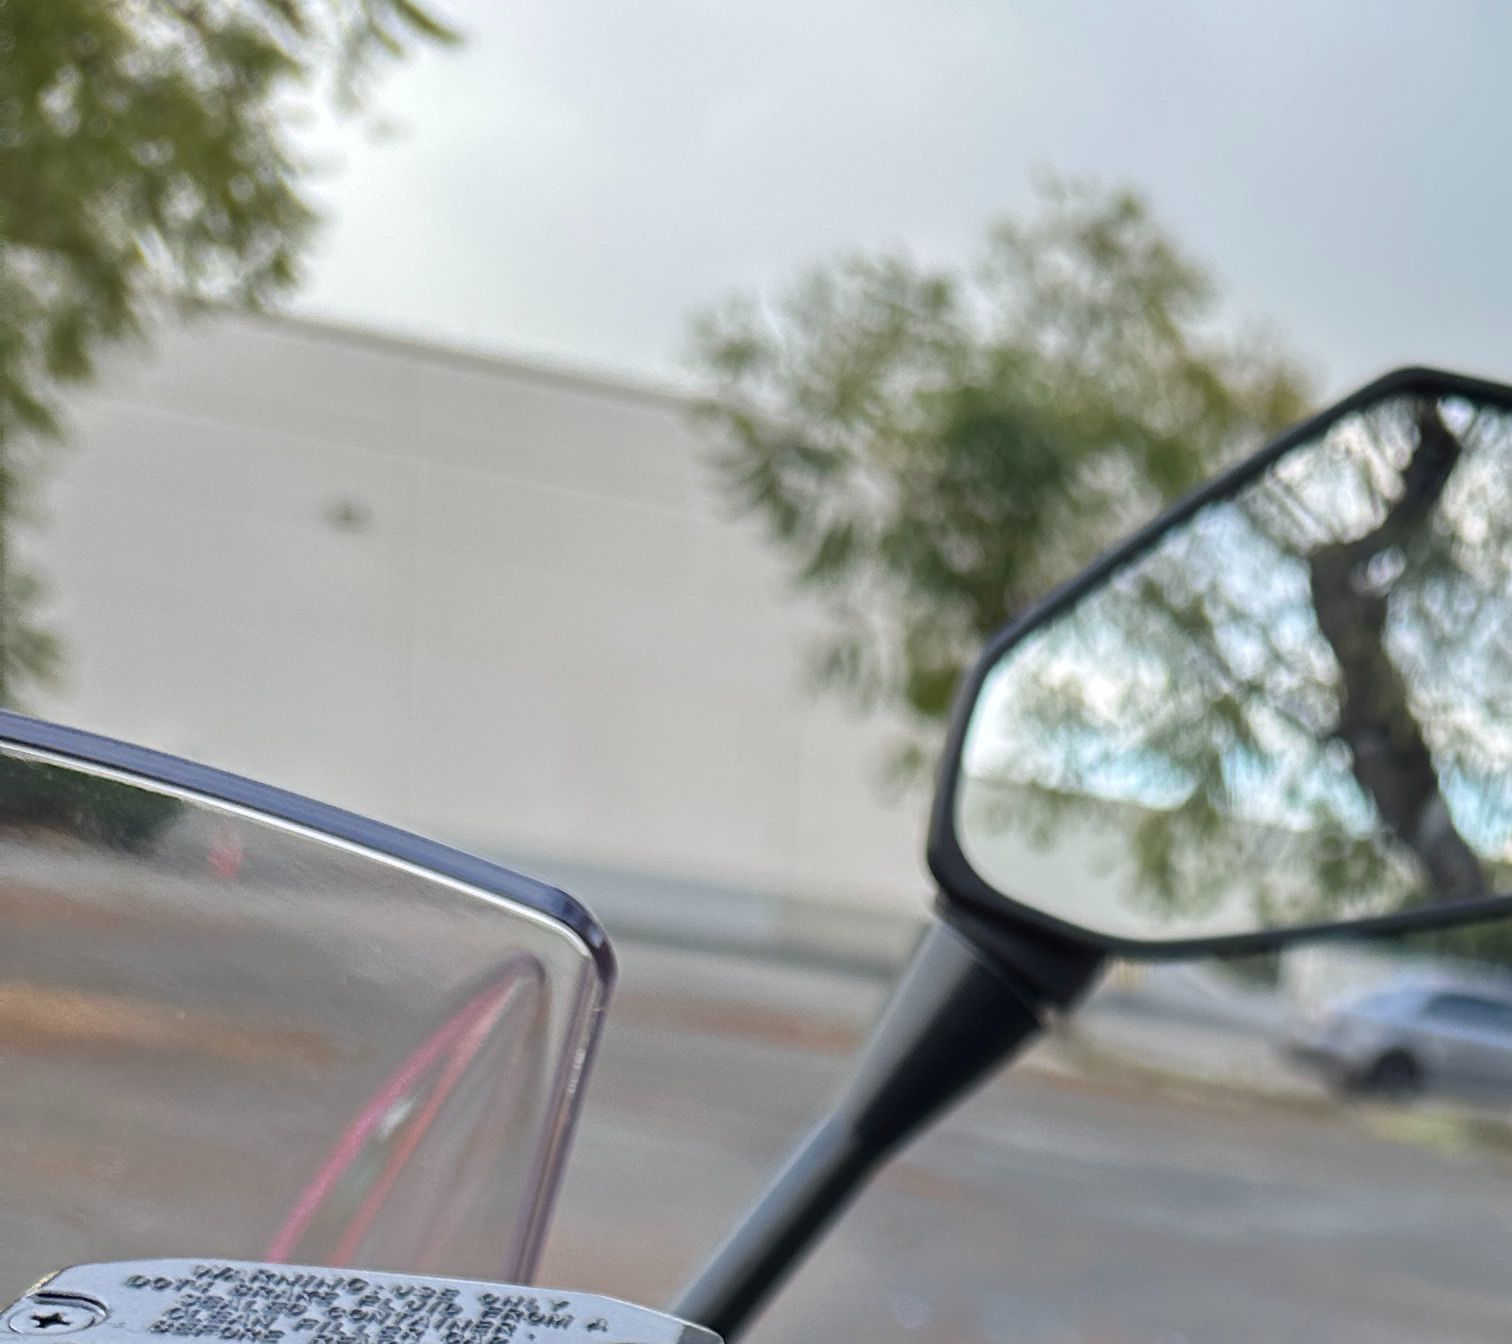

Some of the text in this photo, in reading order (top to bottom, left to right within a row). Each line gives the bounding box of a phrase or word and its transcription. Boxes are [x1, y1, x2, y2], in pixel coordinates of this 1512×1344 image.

[126, 1274, 609, 1333] DOT4 BRAKE FLUID FROM A
[180, 1293, 307, 1316] SEALED
[479, 1293, 570, 1311] ONLY
[149, 1320, 285, 1344] BEFORE
[164, 1306, 278, 1329] CLEAN
[292, 1318, 425, 1341] FILLER
